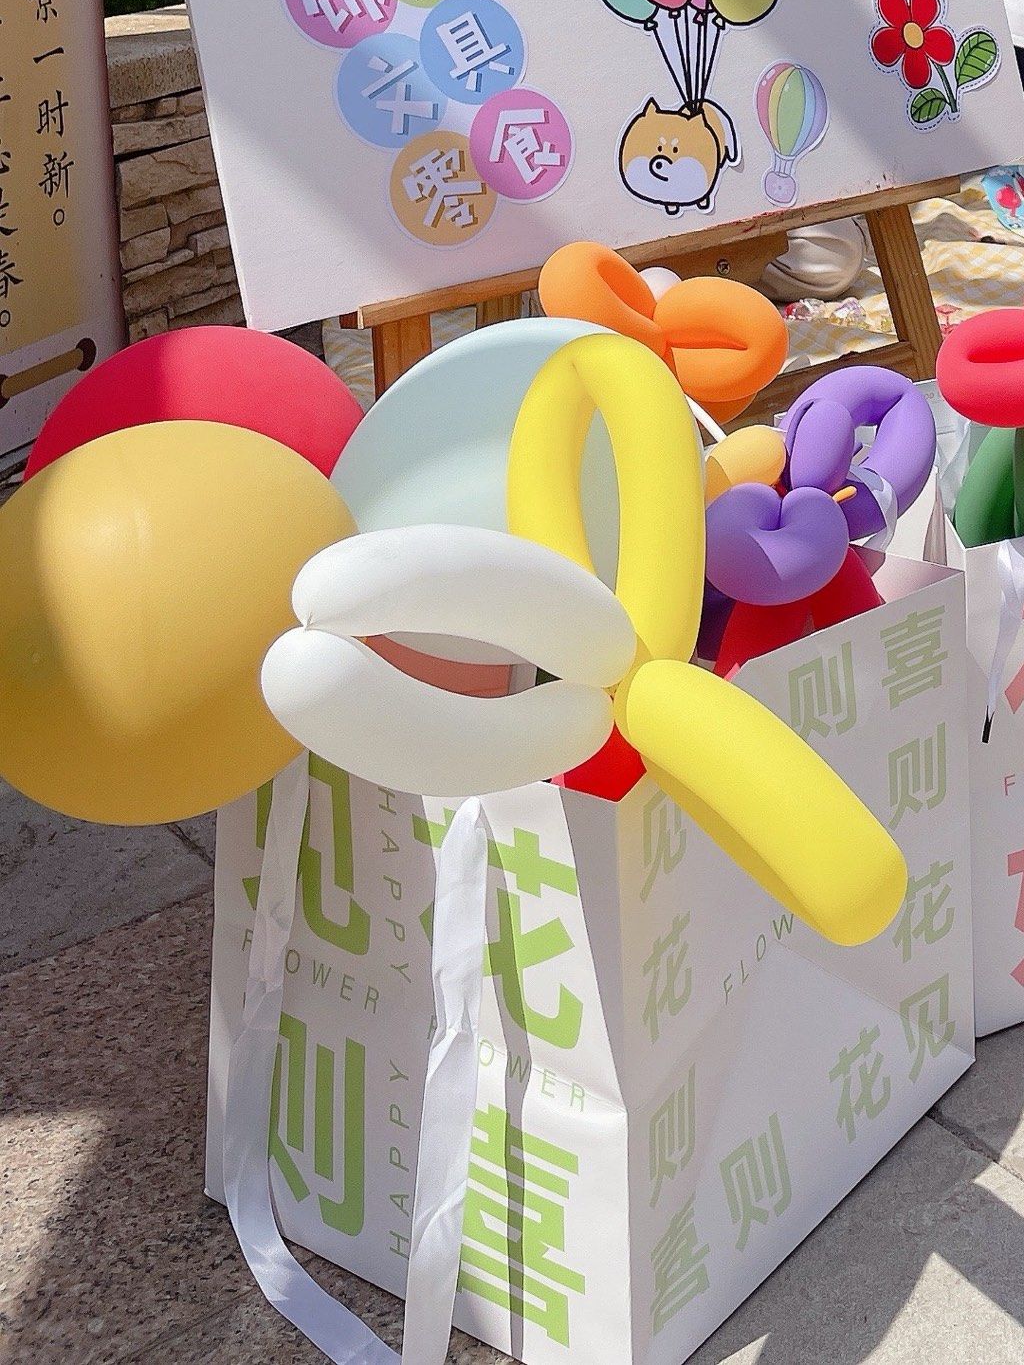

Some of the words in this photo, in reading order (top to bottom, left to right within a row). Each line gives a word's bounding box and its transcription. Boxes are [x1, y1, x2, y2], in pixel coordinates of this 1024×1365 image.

[362, 11, 515, 135] 文具
[404, 108, 566, 229] 零食
[376, 786, 412, 983] HAPPY
[242, 928, 380, 1014] FOWER
[722, 911, 796, 1005] FLOW
[427, 1014, 586, 1113] FOWER
[388, 1059, 411, 1261] HAPPY
